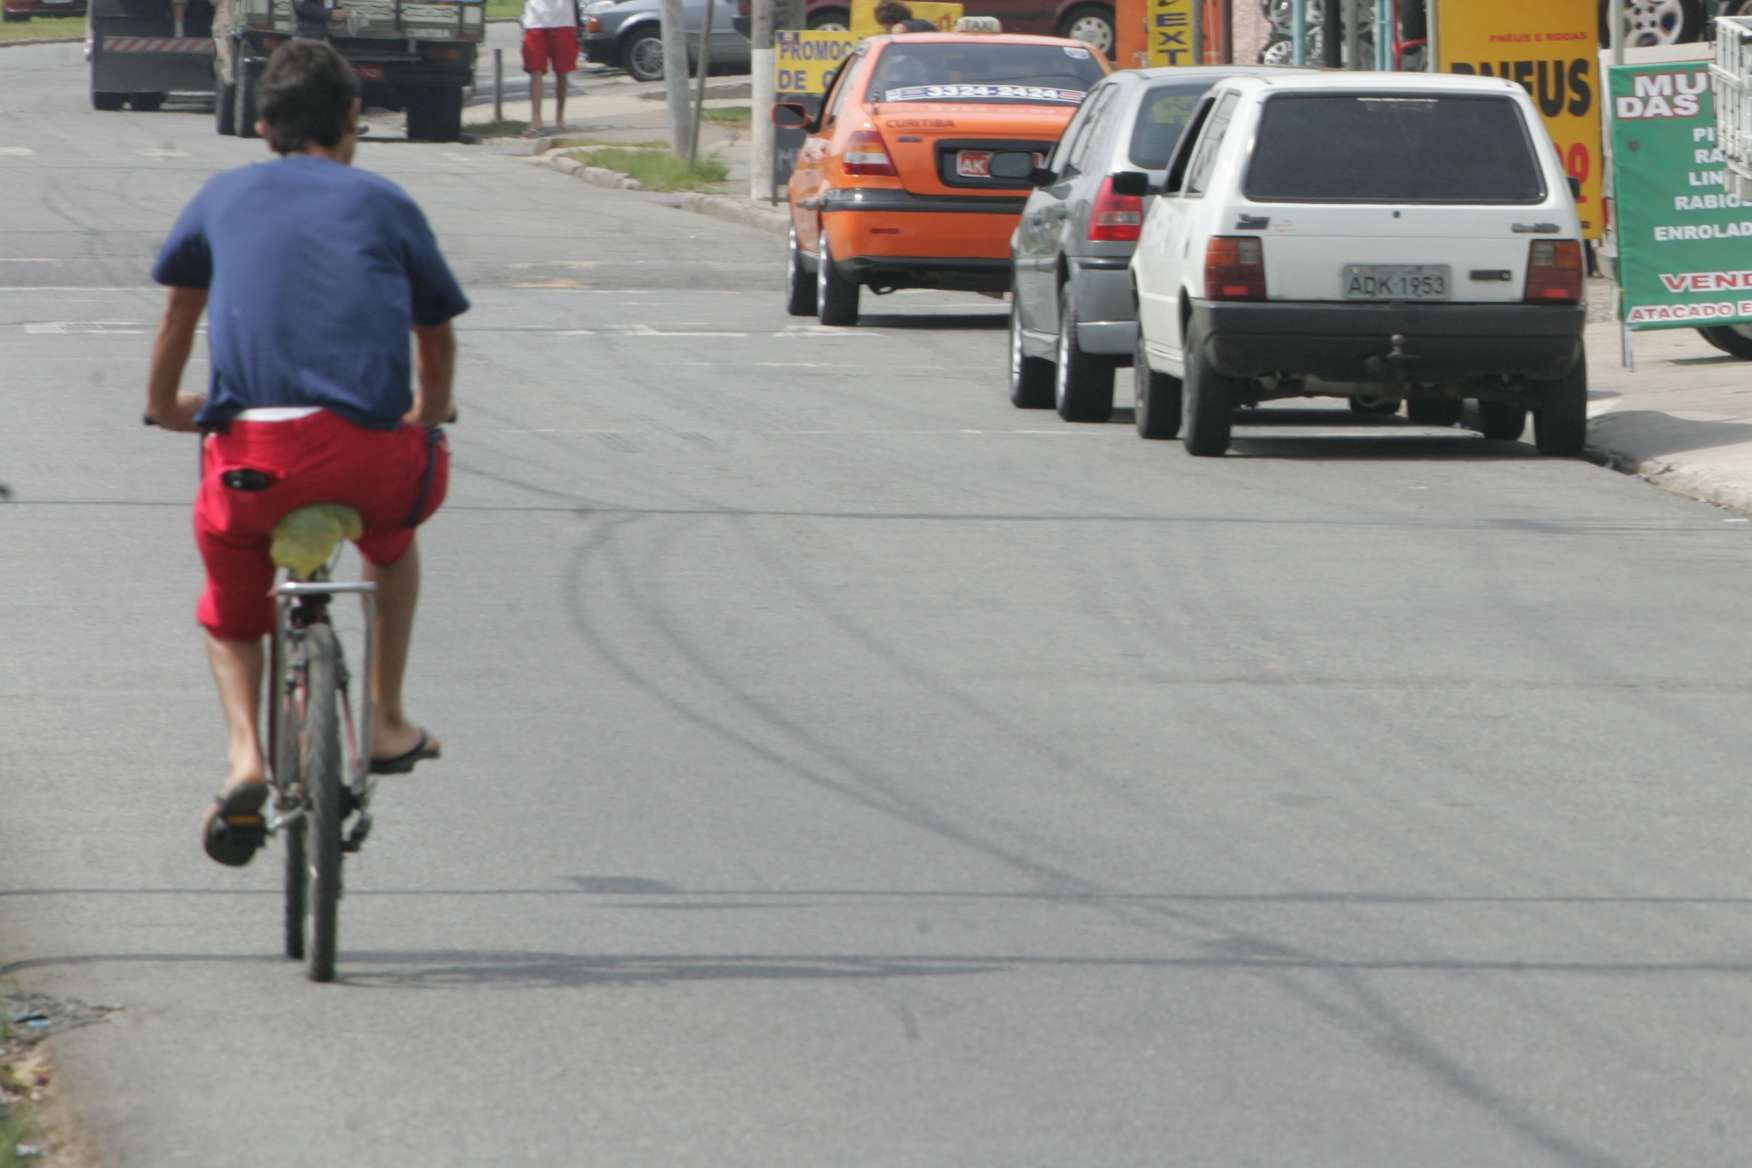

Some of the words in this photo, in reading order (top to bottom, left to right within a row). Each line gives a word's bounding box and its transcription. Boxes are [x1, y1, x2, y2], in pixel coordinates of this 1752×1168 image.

[964, 18, 996, 31] TAXI
[777, 69, 807, 91] DE
[1451, 57, 1592, 118] EUS
[1615, 92, 1700, 119] DAS
[1688, 170, 1725, 187] LIN
[1629, 303, 1734, 322] ATACADO
